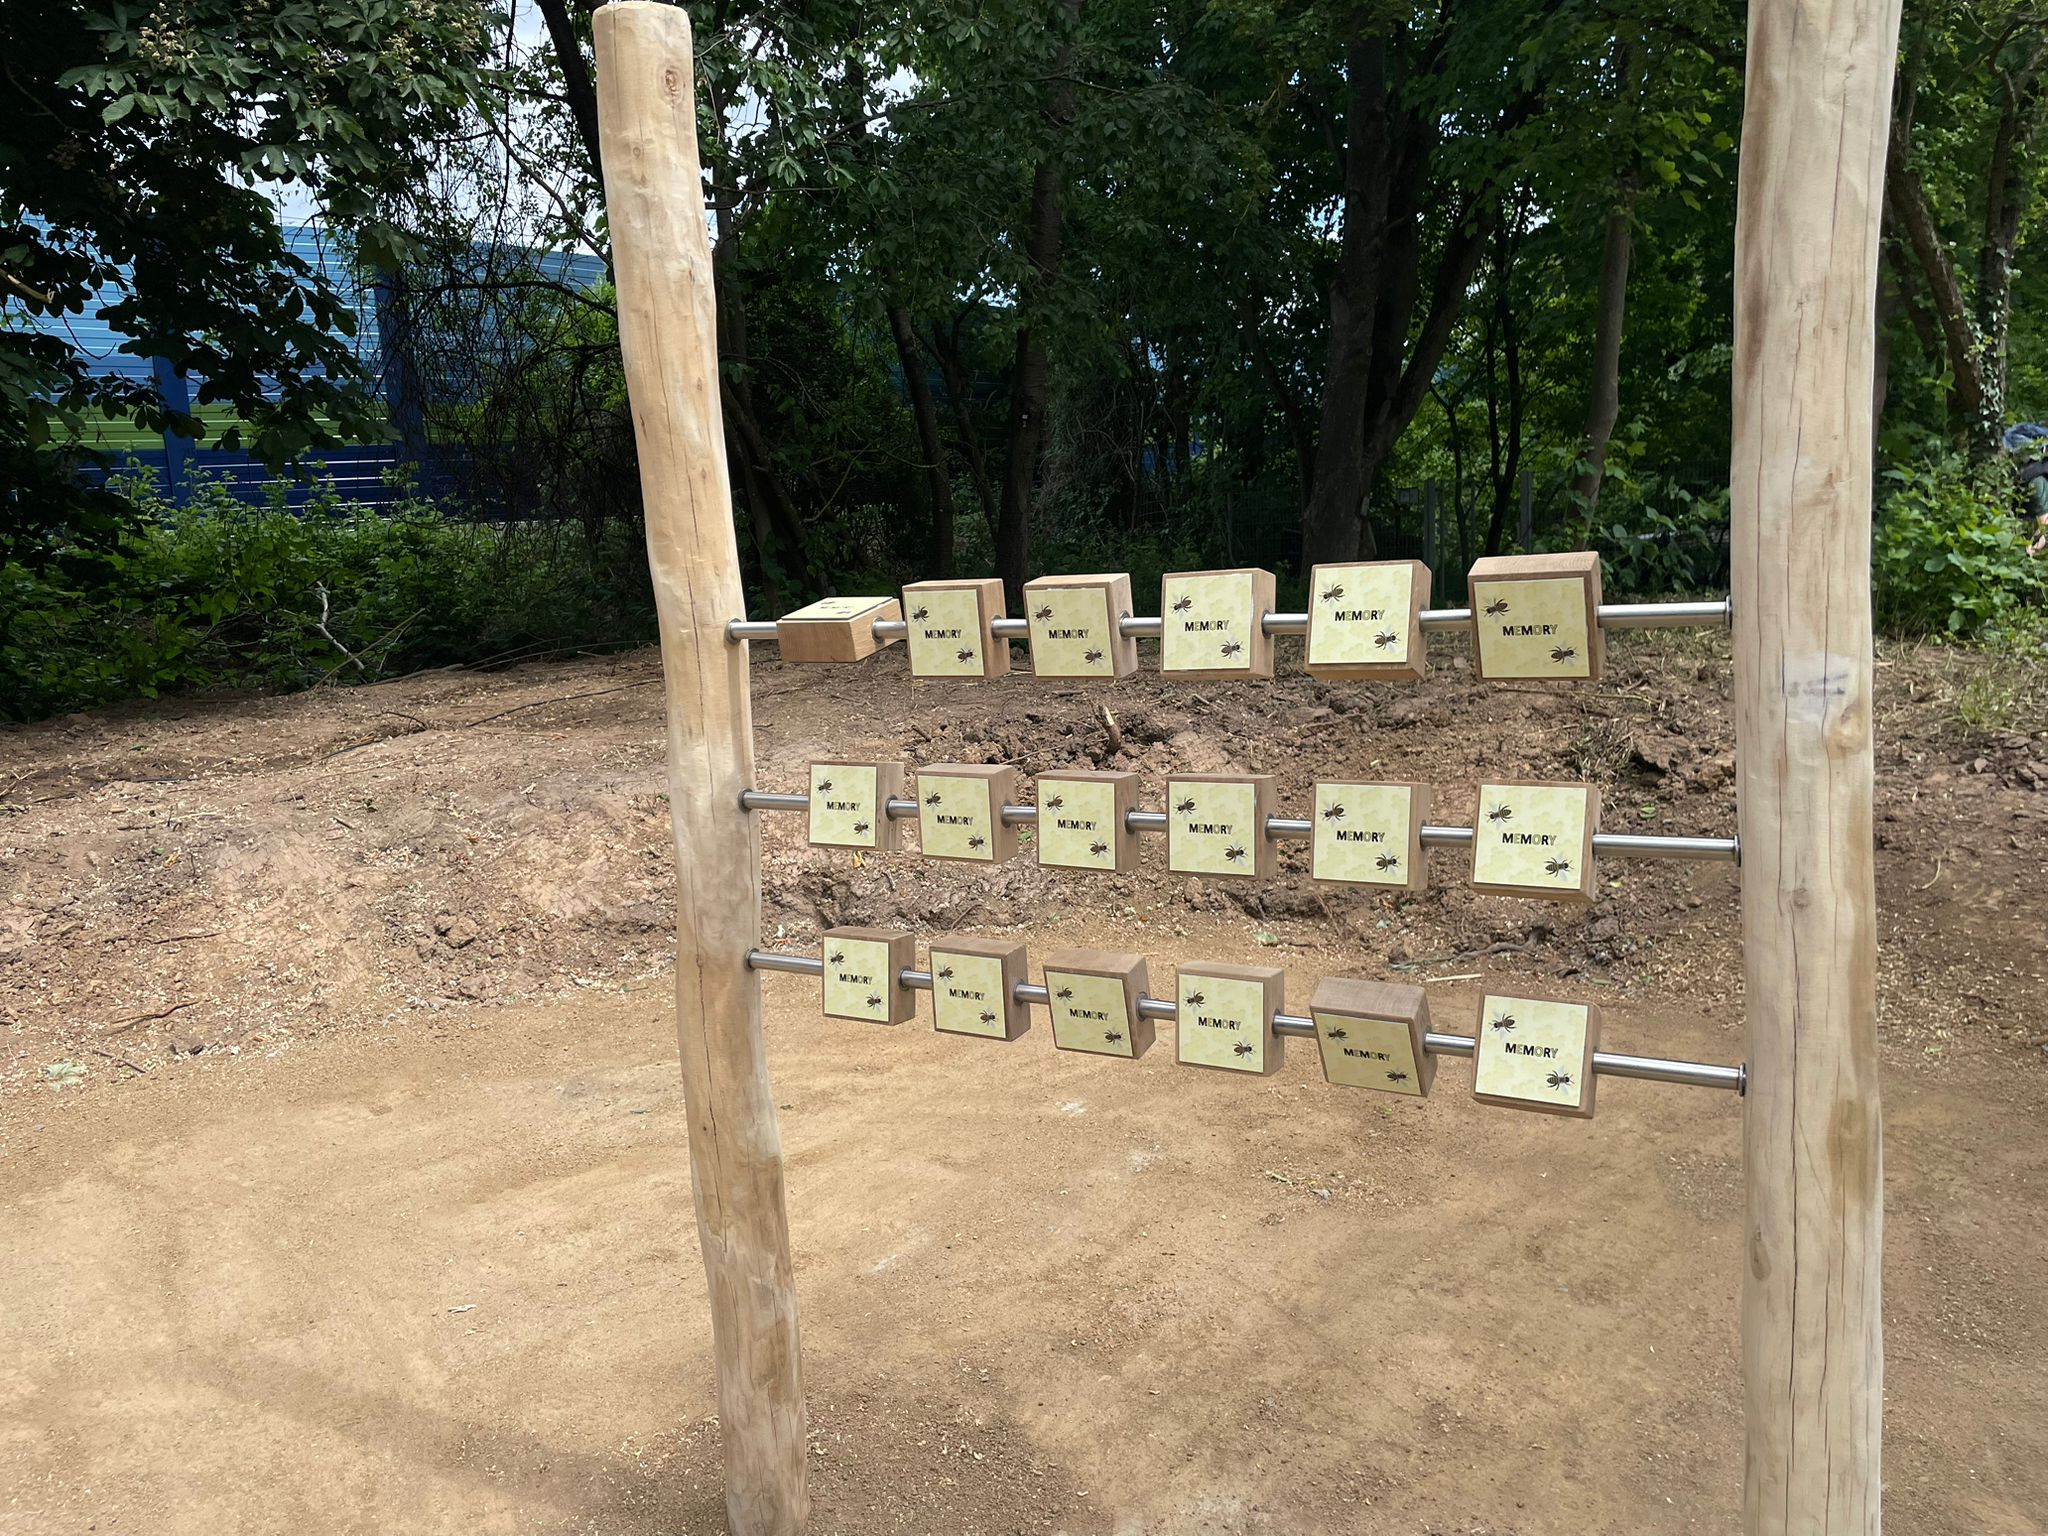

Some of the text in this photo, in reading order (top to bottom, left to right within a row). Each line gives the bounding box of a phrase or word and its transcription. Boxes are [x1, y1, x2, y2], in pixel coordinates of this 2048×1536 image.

[1334, 609, 1386, 622] MEMORY
[1184, 619, 1230, 632] MEMORY
[1502, 623, 1558, 637] MEMORY
[924, 628, 962, 639] MEMORY
[1048, 628, 1089, 640] MEMORY
[826, 801, 861, 812] MEMORY
[936, 814, 974, 826] MEMORY
[1057, 818, 1097, 831] MEMORY
[1188, 822, 1233, 835] MEMORY
[1336, 829, 1386, 843] MEMORY
[1501, 832, 1557, 846] MEMORY
[839, 972, 873, 985] MEMORY
[948, 988, 985, 1001] MEMORY
[1069, 1008, 1109, 1021] MEMORY
[1197, 1016, 1241, 1031] MEMORY
[1343, 1047, 1391, 1062] MEMORY
[1504, 1042, 1559, 1059] MEMORY
